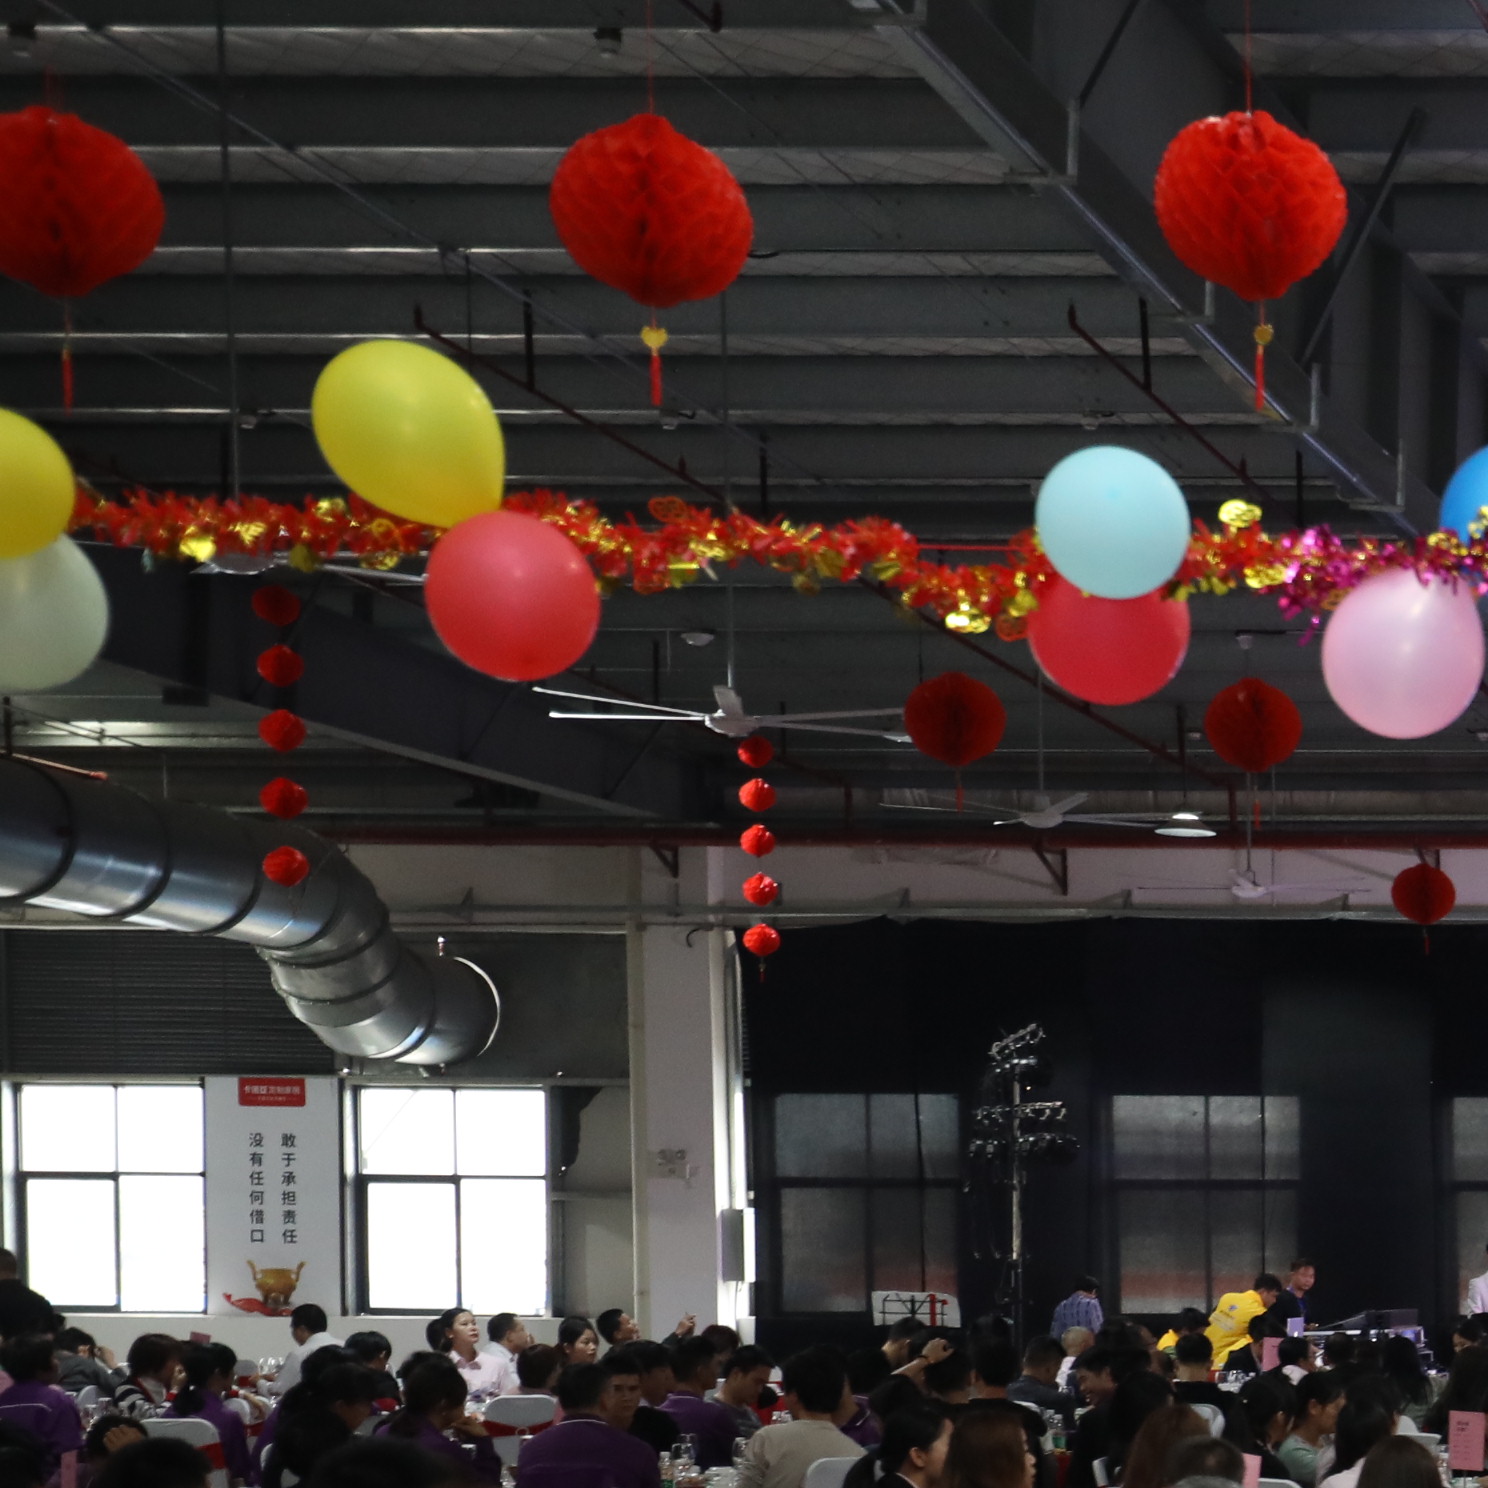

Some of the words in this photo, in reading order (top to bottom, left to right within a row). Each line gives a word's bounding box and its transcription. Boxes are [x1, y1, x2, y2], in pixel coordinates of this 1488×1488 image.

[249, 1132, 265, 1244] 没有任何借口
[281, 1133, 297, 1245] 敢于承担责任
